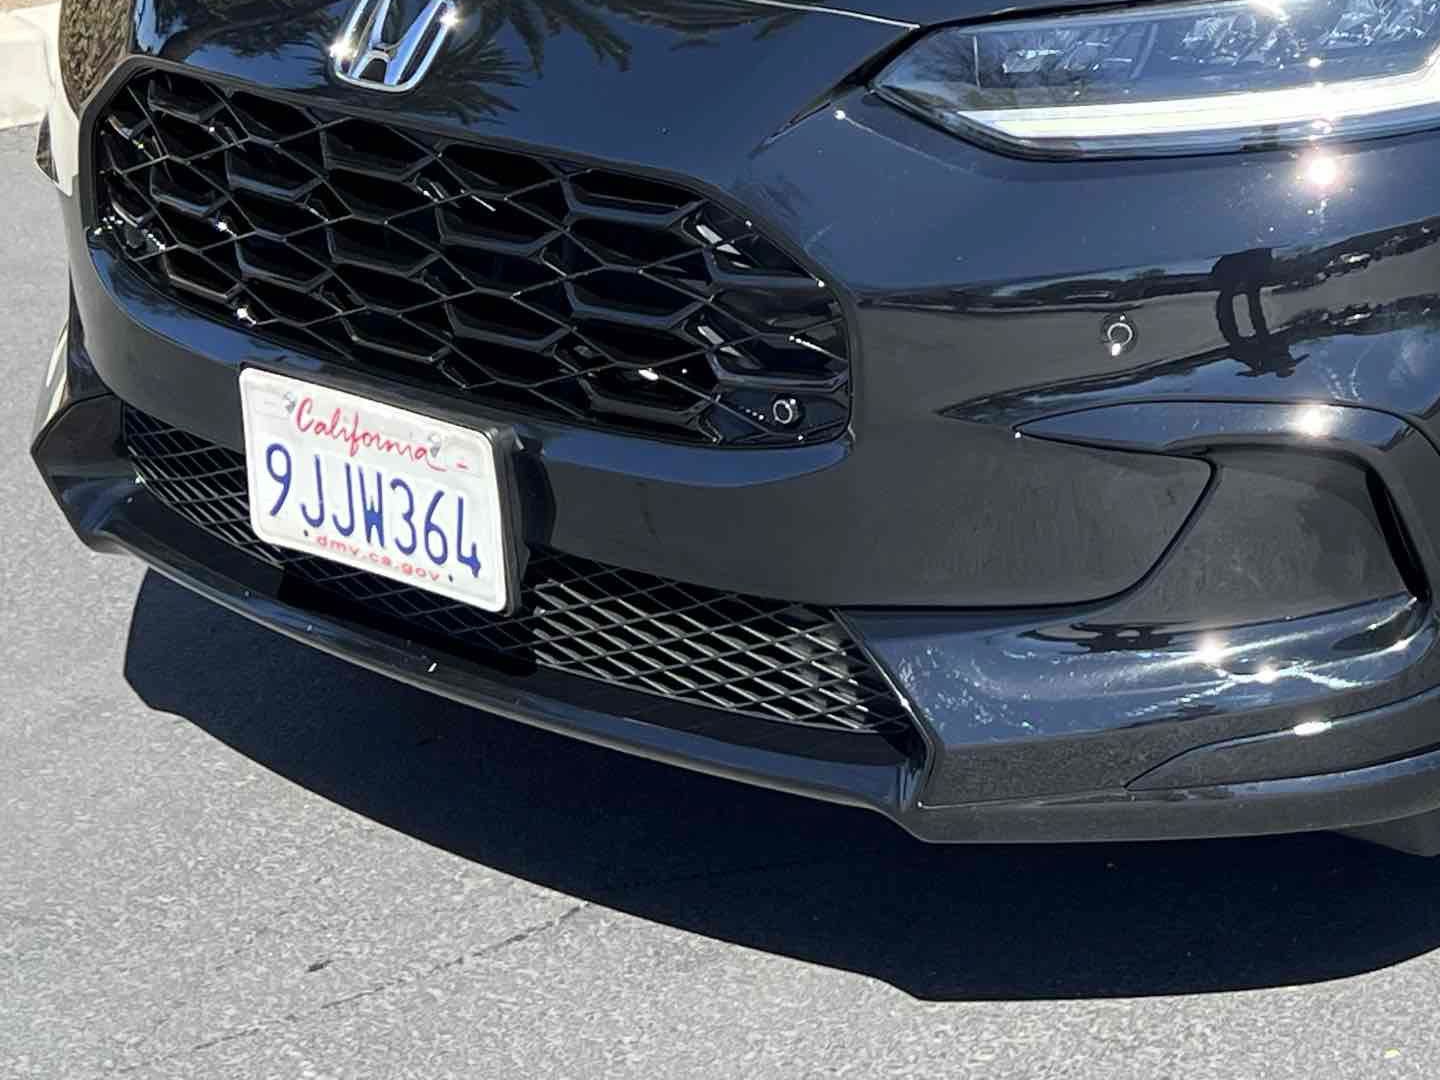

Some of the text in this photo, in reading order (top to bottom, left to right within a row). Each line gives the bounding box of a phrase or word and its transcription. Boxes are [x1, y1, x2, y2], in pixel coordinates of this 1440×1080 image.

[296, 397, 447, 472] California
[266, 443, 481, 577] 9JJW364
[316, 535, 440, 581] dmv.ca.gov
